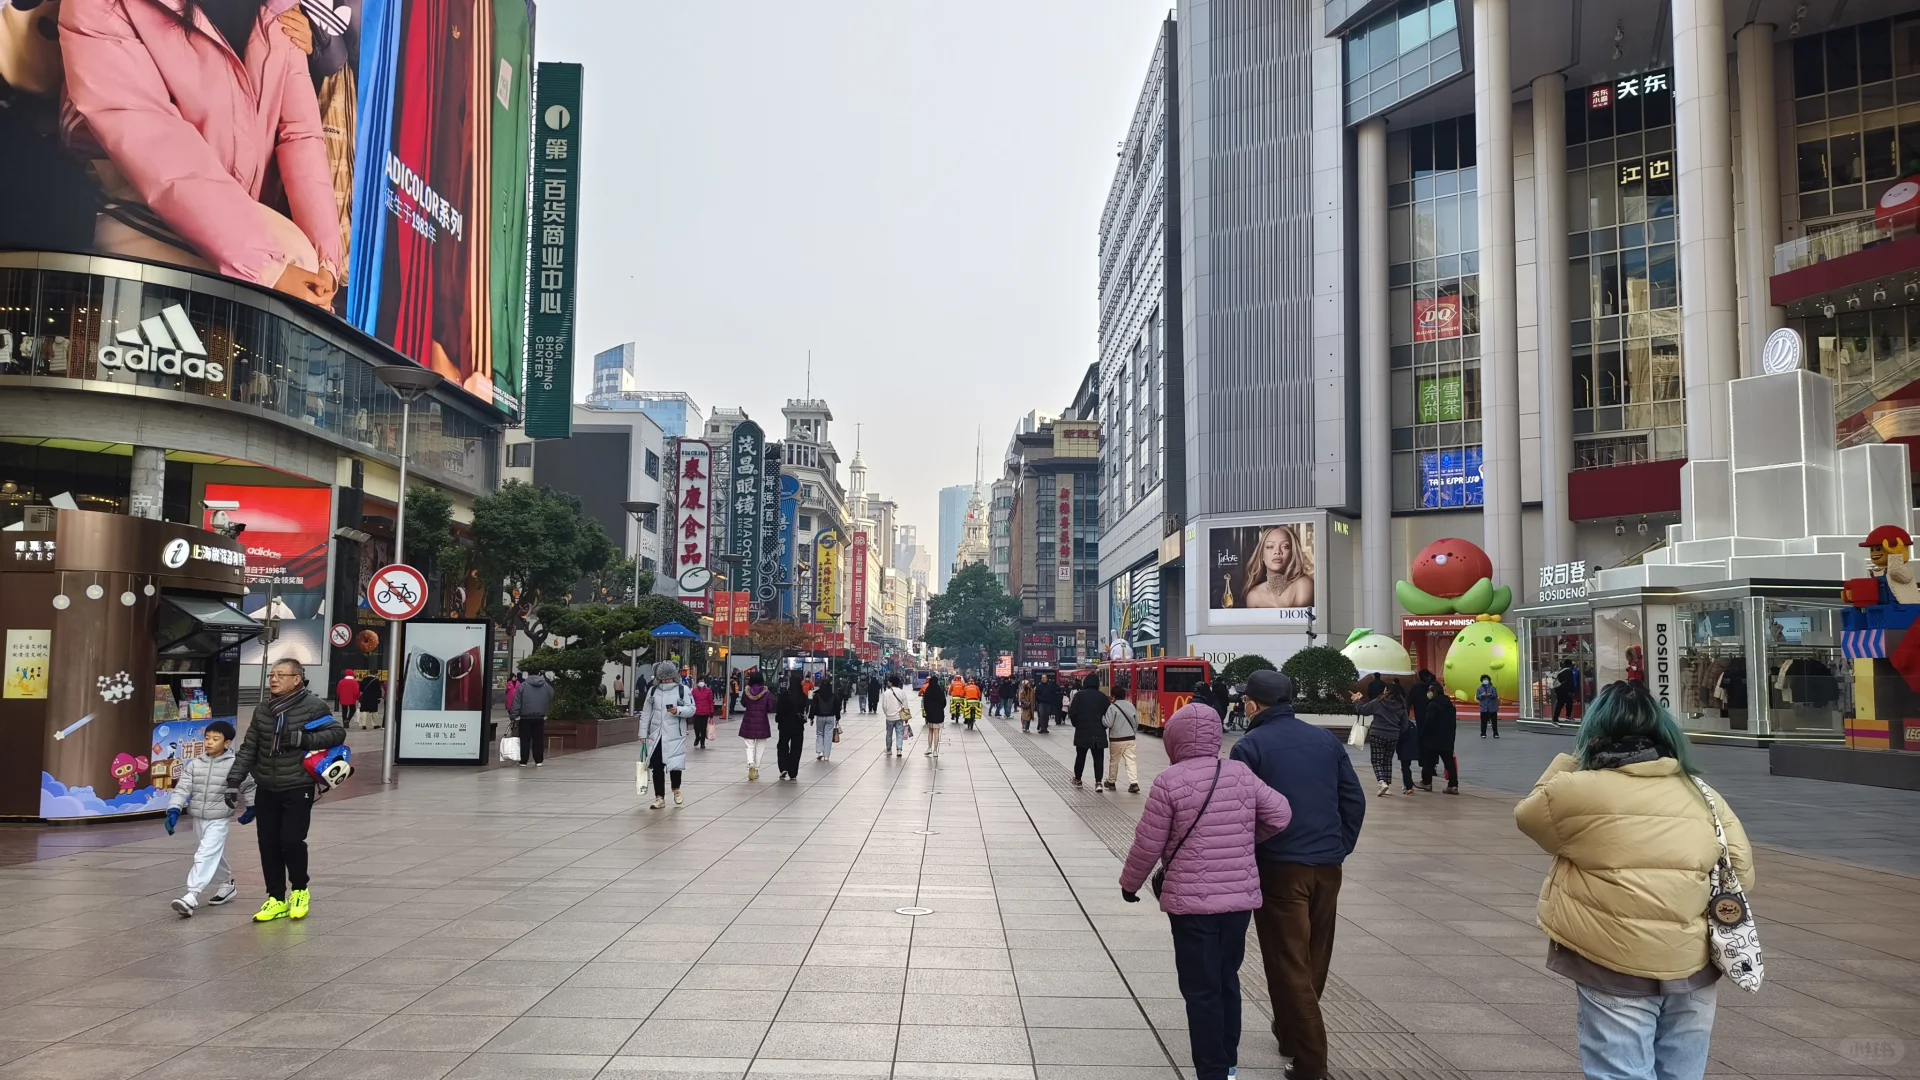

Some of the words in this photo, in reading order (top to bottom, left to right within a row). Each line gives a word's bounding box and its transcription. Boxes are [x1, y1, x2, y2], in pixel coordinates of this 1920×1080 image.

[1620, 160, 1670, 185] 江边
[540, 138, 568, 314] 第一百货商业中心
[1425, 308, 1452, 323] DQ
[98, 344, 224, 382] adidas
[535, 336, 544, 379] CENTER
[545, 336, 555, 391] SHOPPING
[734, 435, 758, 516] 茂昌眼镜
[679, 456, 707, 566] 泰康食品
[15, 551, 54, 561] TKTS
[247, 546, 282, 560] adidas
[1539, 560, 1586, 588] 波司登
[1539, 586, 1585, 602] BOSIDENG
[1279, 609, 1309, 619] DIOR
[1430, 619, 1444, 627] Fair
[1656, 623, 1670, 709] BOSIDENG
[443, 721, 459, 729] Mate
